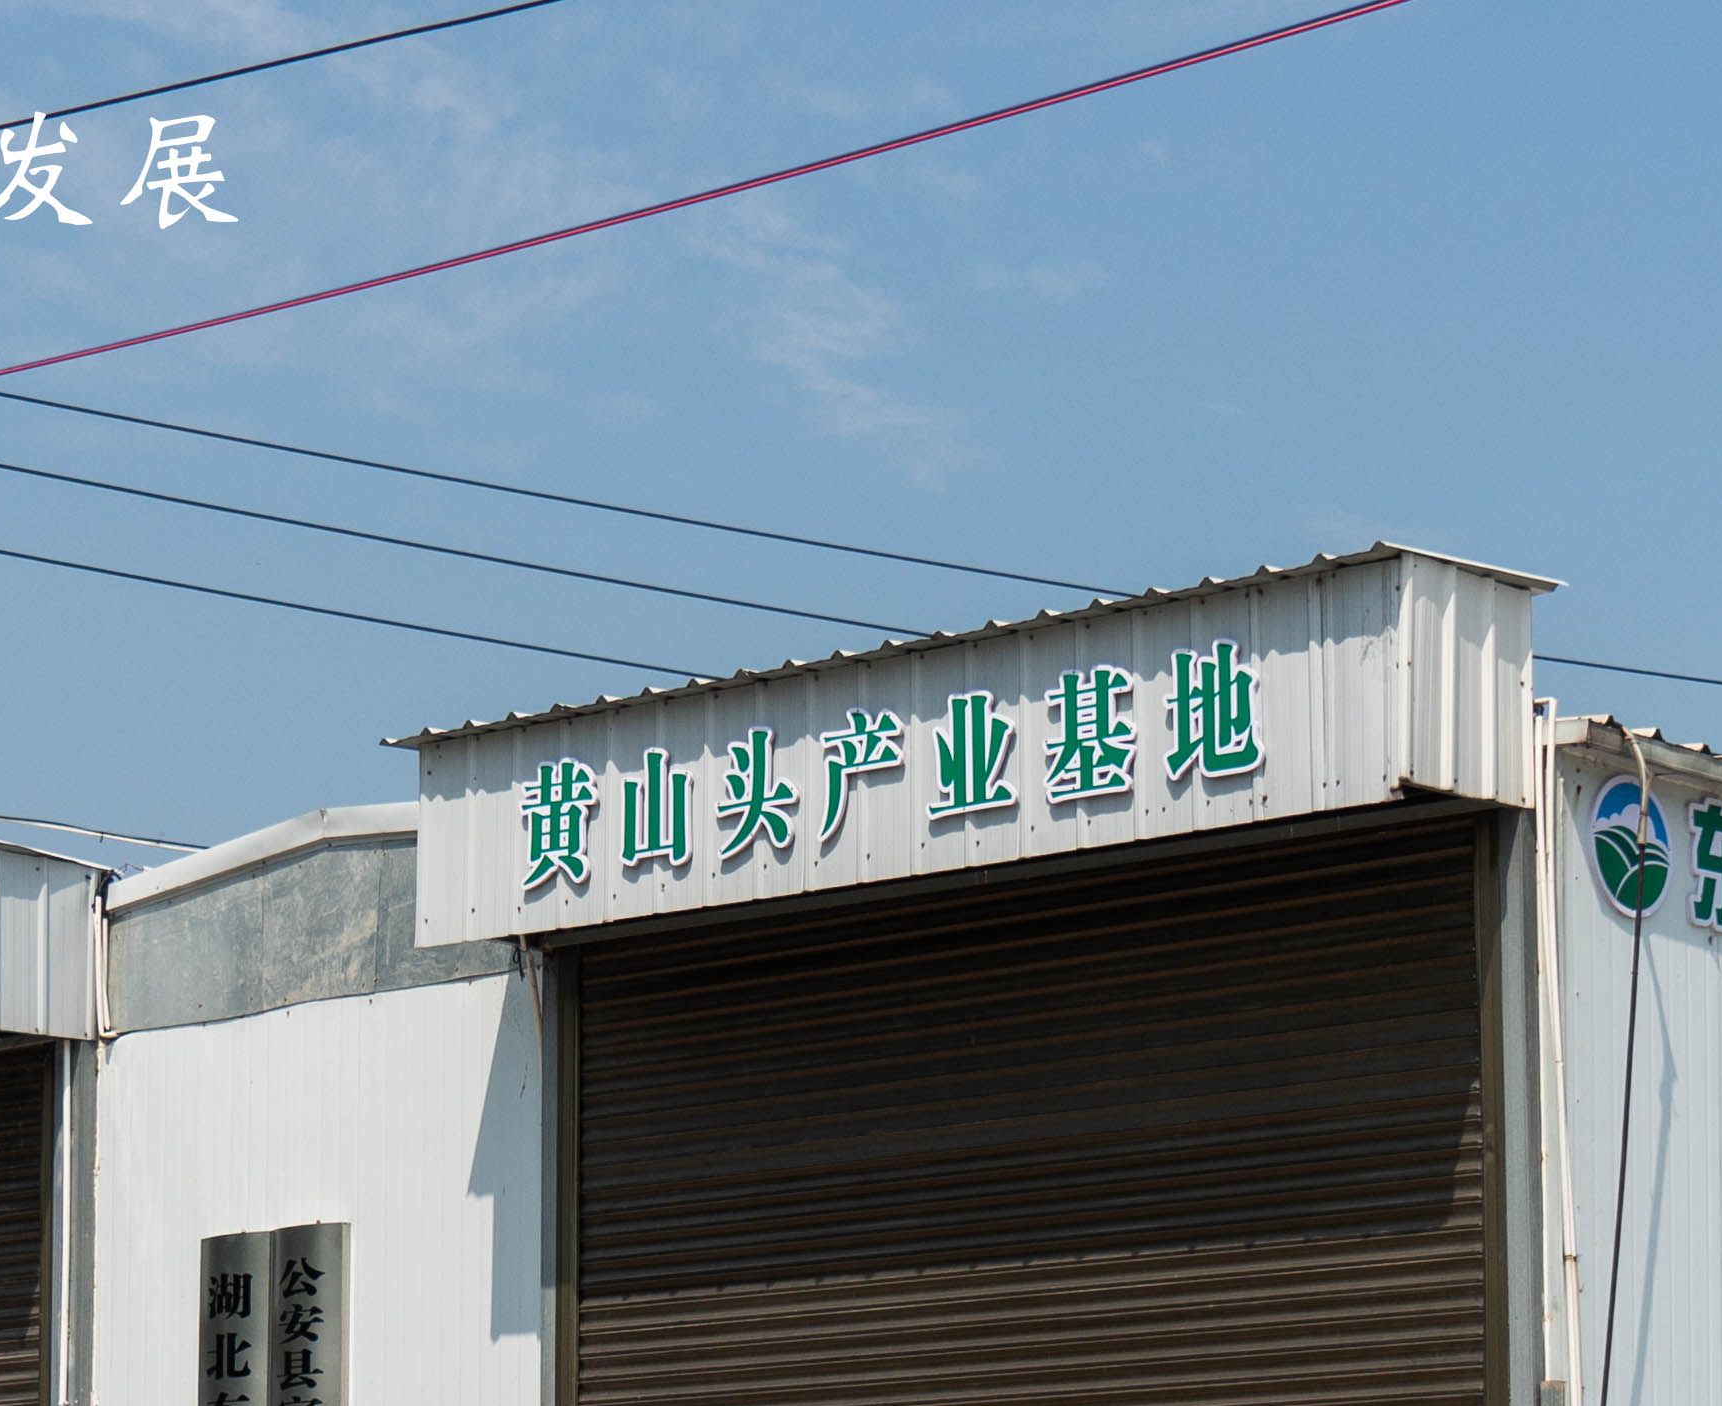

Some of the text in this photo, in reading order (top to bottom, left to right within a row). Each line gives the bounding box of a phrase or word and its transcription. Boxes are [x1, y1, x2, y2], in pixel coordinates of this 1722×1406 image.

[523, 640, 1261, 886] 黄山头产业基地
